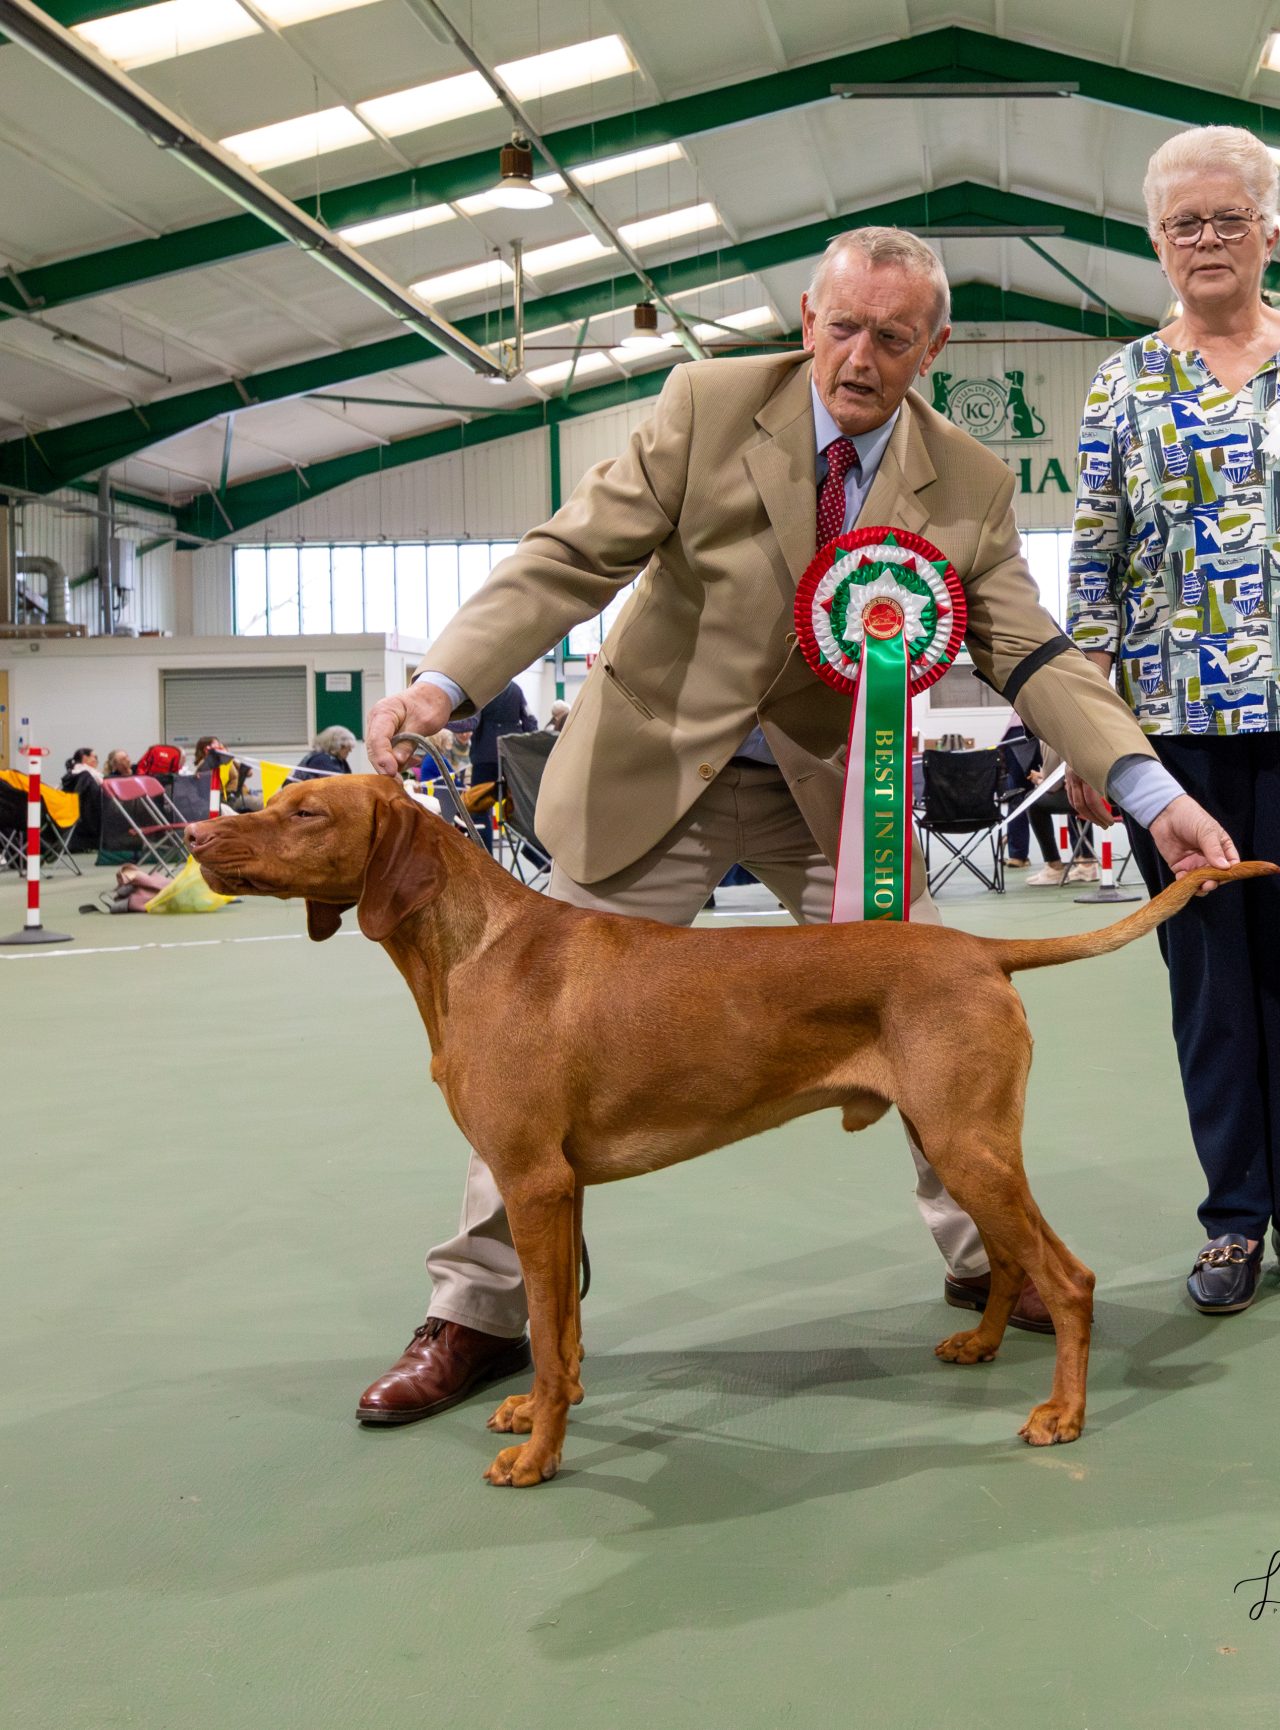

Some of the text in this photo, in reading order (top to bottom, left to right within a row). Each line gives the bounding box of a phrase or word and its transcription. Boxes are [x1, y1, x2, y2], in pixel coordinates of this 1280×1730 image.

[966, 402, 991, 419] KC
[1001, 457, 1077, 493] HA
[874, 730, 894, 800] BEST
[874, 811, 894, 838] IN
